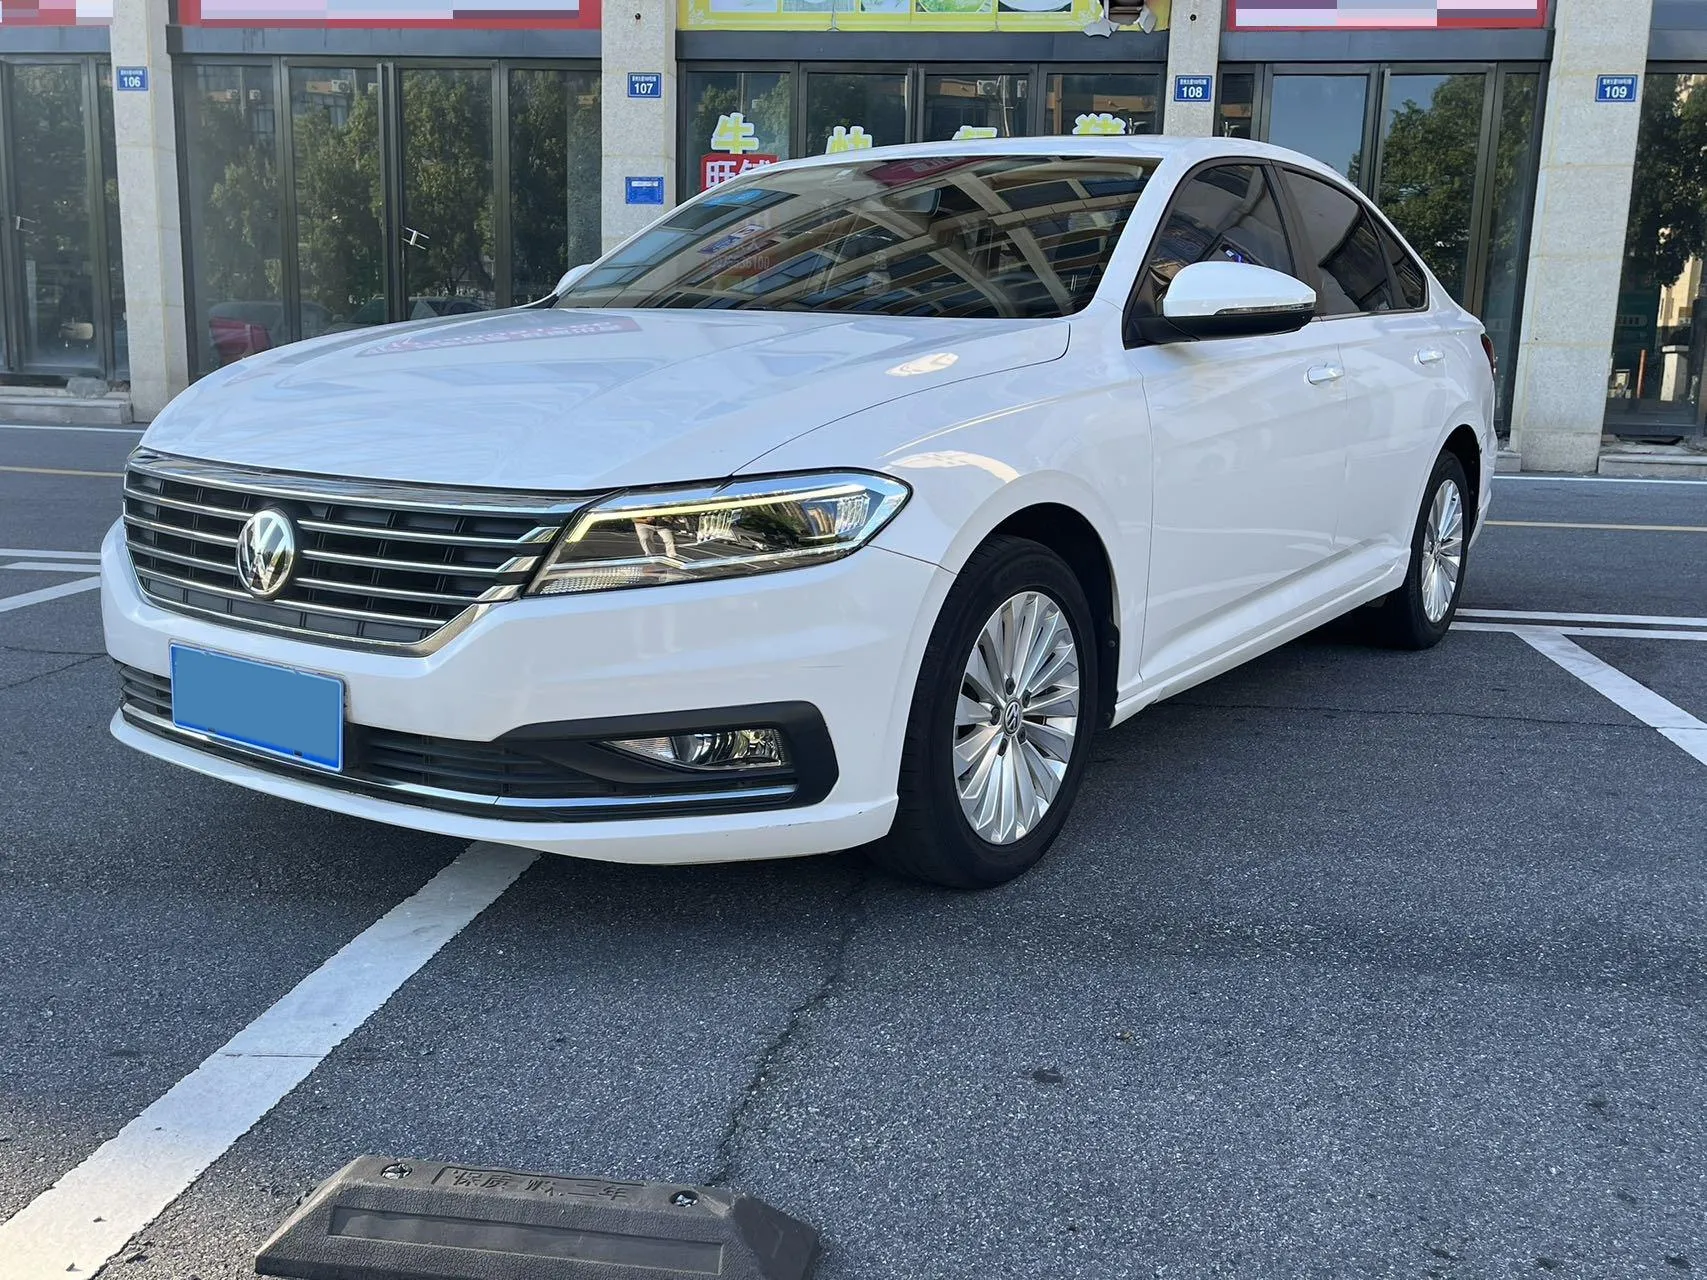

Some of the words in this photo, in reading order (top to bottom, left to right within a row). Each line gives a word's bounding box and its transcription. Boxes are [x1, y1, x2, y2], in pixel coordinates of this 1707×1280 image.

[123, 76, 141, 88] 106
[634, 83, 654, 94] 107
[1182, 86, 1203, 98] 108
[1604, 86, 1627, 98] 109
[711, 112, 760, 154] 牛
[706, 159, 770, 188] 旺
